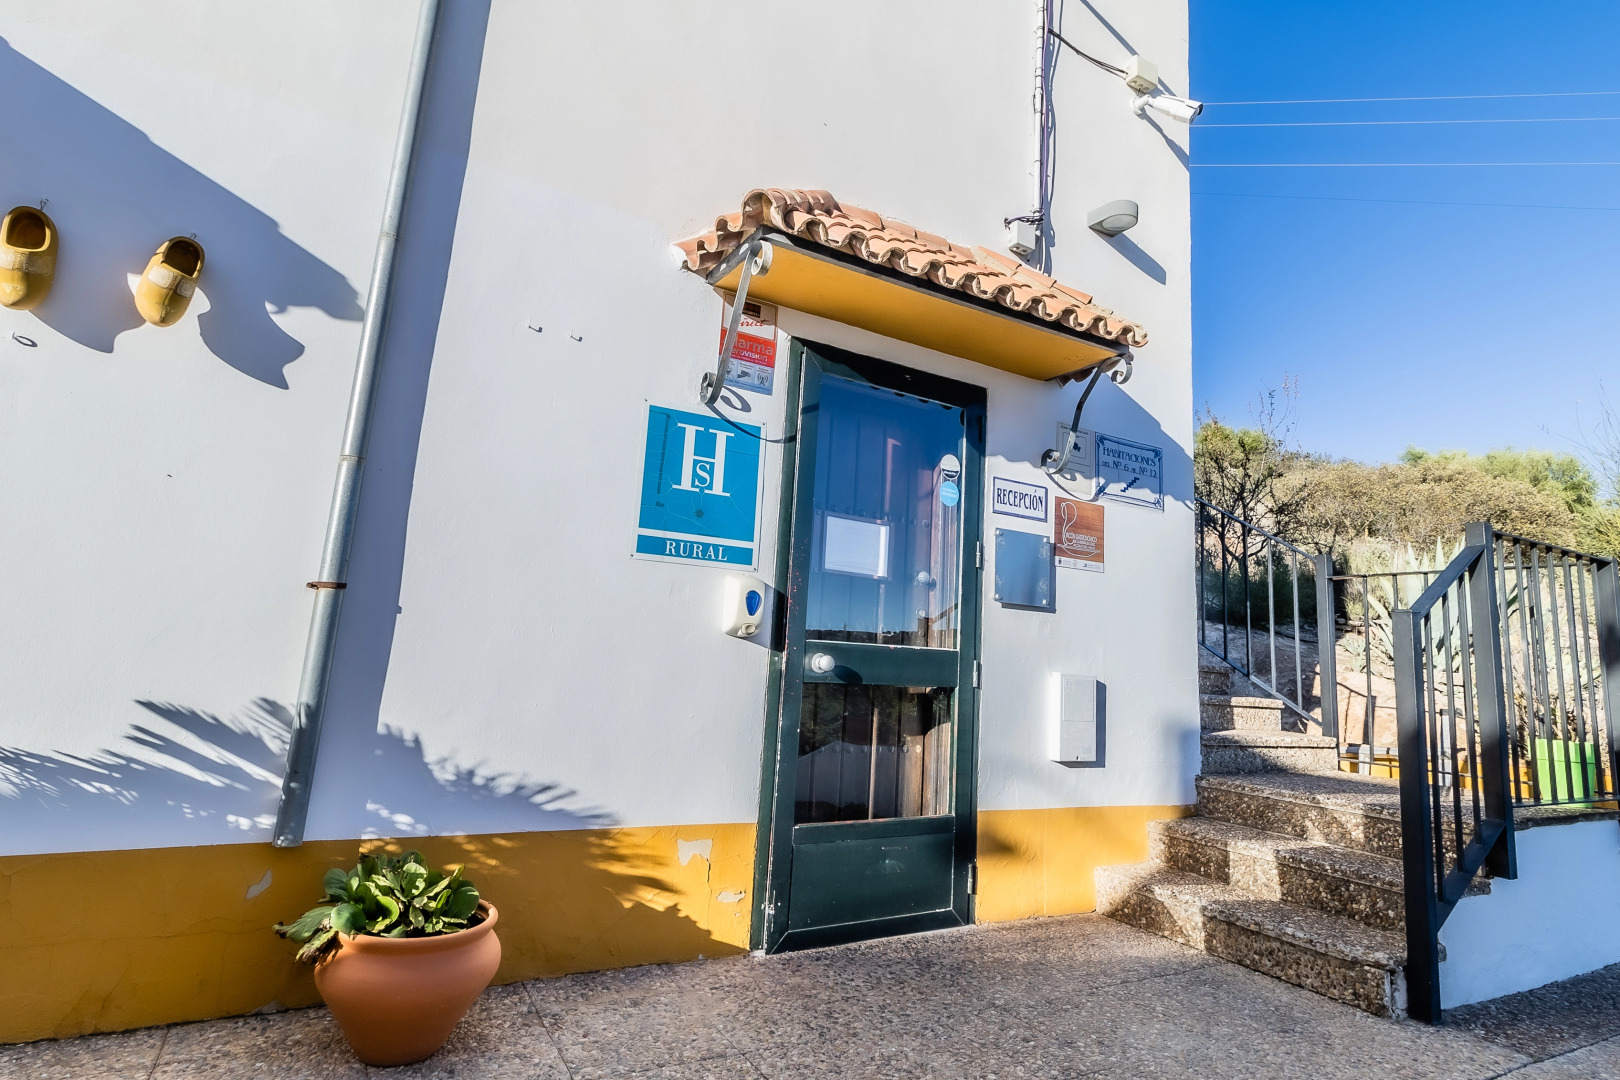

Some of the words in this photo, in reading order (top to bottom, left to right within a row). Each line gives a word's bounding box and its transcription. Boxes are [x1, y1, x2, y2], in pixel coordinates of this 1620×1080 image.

[733, 339, 773, 355] larma
[1102, 446, 1156, 467] HABITACIONES
[1123, 463, 1130, 472] 6
[1149, 468, 1158, 479] 12
[996, 487, 1044, 513] RECEPCIÓN
[664, 539, 728, 561] RURAL
